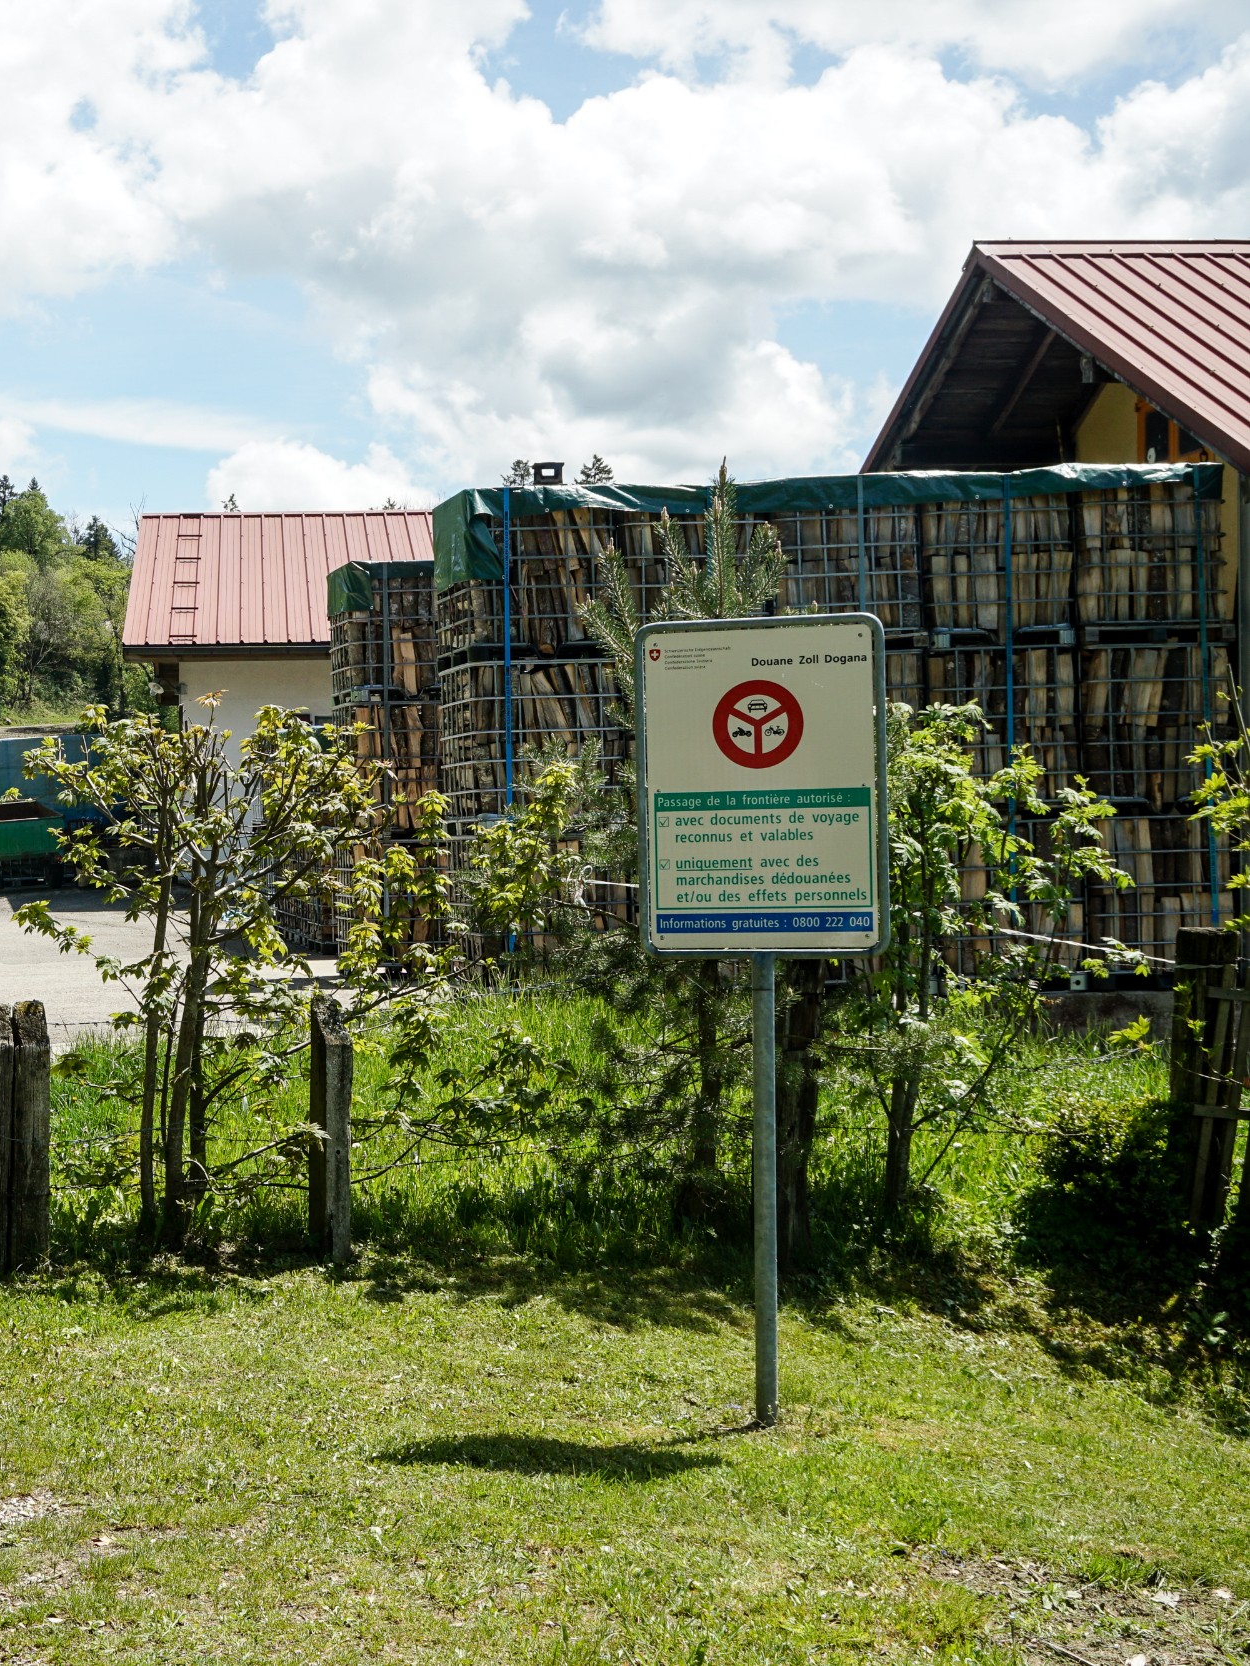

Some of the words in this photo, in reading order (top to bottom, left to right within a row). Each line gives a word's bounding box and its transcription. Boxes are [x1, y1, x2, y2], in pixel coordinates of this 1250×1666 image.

[751, 656, 793, 666] Douane
[799, 655, 819, 664] Zoll
[825, 654, 867, 665] Dogana
[658, 797, 701, 808] Passage
[707, 796, 720, 806] de
[726, 795, 736, 805] la
[742, 794, 790, 804] frontière
[796, 793, 843, 803] autorisé
[675, 816, 703, 826] avec
[710, 813, 781, 826] documents
[789, 811, 804, 823] de
[812, 812, 859, 825] voyage
[675, 833, 732, 843] reconnus
[740, 831, 753, 841] et
[760, 829, 813, 841] valables
[676, 857, 752, 870] uniquement
[760, 857, 789, 867] avec
[796, 855, 819, 866] des
[676, 873, 764, 885] marchandises
[771, 872, 851, 884] dédouanées
[676, 891, 711, 902] et/ou
[718, 890, 741, 902] des
[748, 889, 787, 901] effets
[795, 888, 867, 904] personnels
[660, 918, 726, 928] Informations
[732, 918, 779, 930] gratuites
[792, 917, 820, 927] 0800
[825, 917, 844, 926] 222
[850, 916, 870, 926] 040
